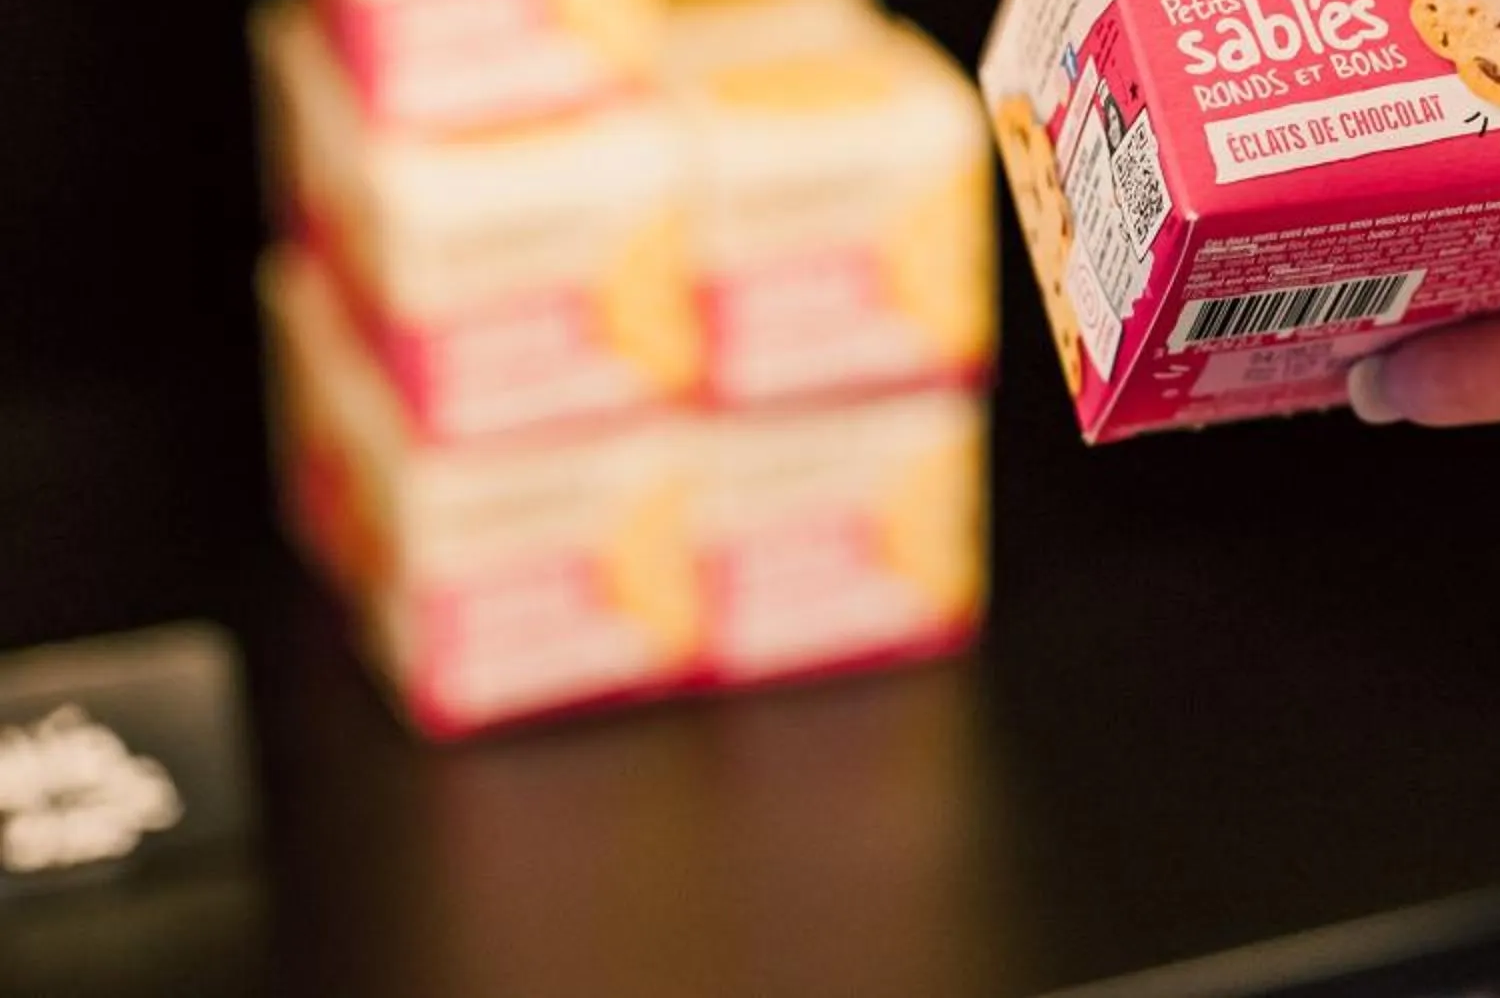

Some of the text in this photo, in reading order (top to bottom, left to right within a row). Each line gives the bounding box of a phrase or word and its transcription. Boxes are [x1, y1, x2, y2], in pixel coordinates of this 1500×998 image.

[1193, 44, 1408, 112] RONDS ET BONS
[1226, 94, 1448, 164] ÉCLATS DE CHOCOLAT
